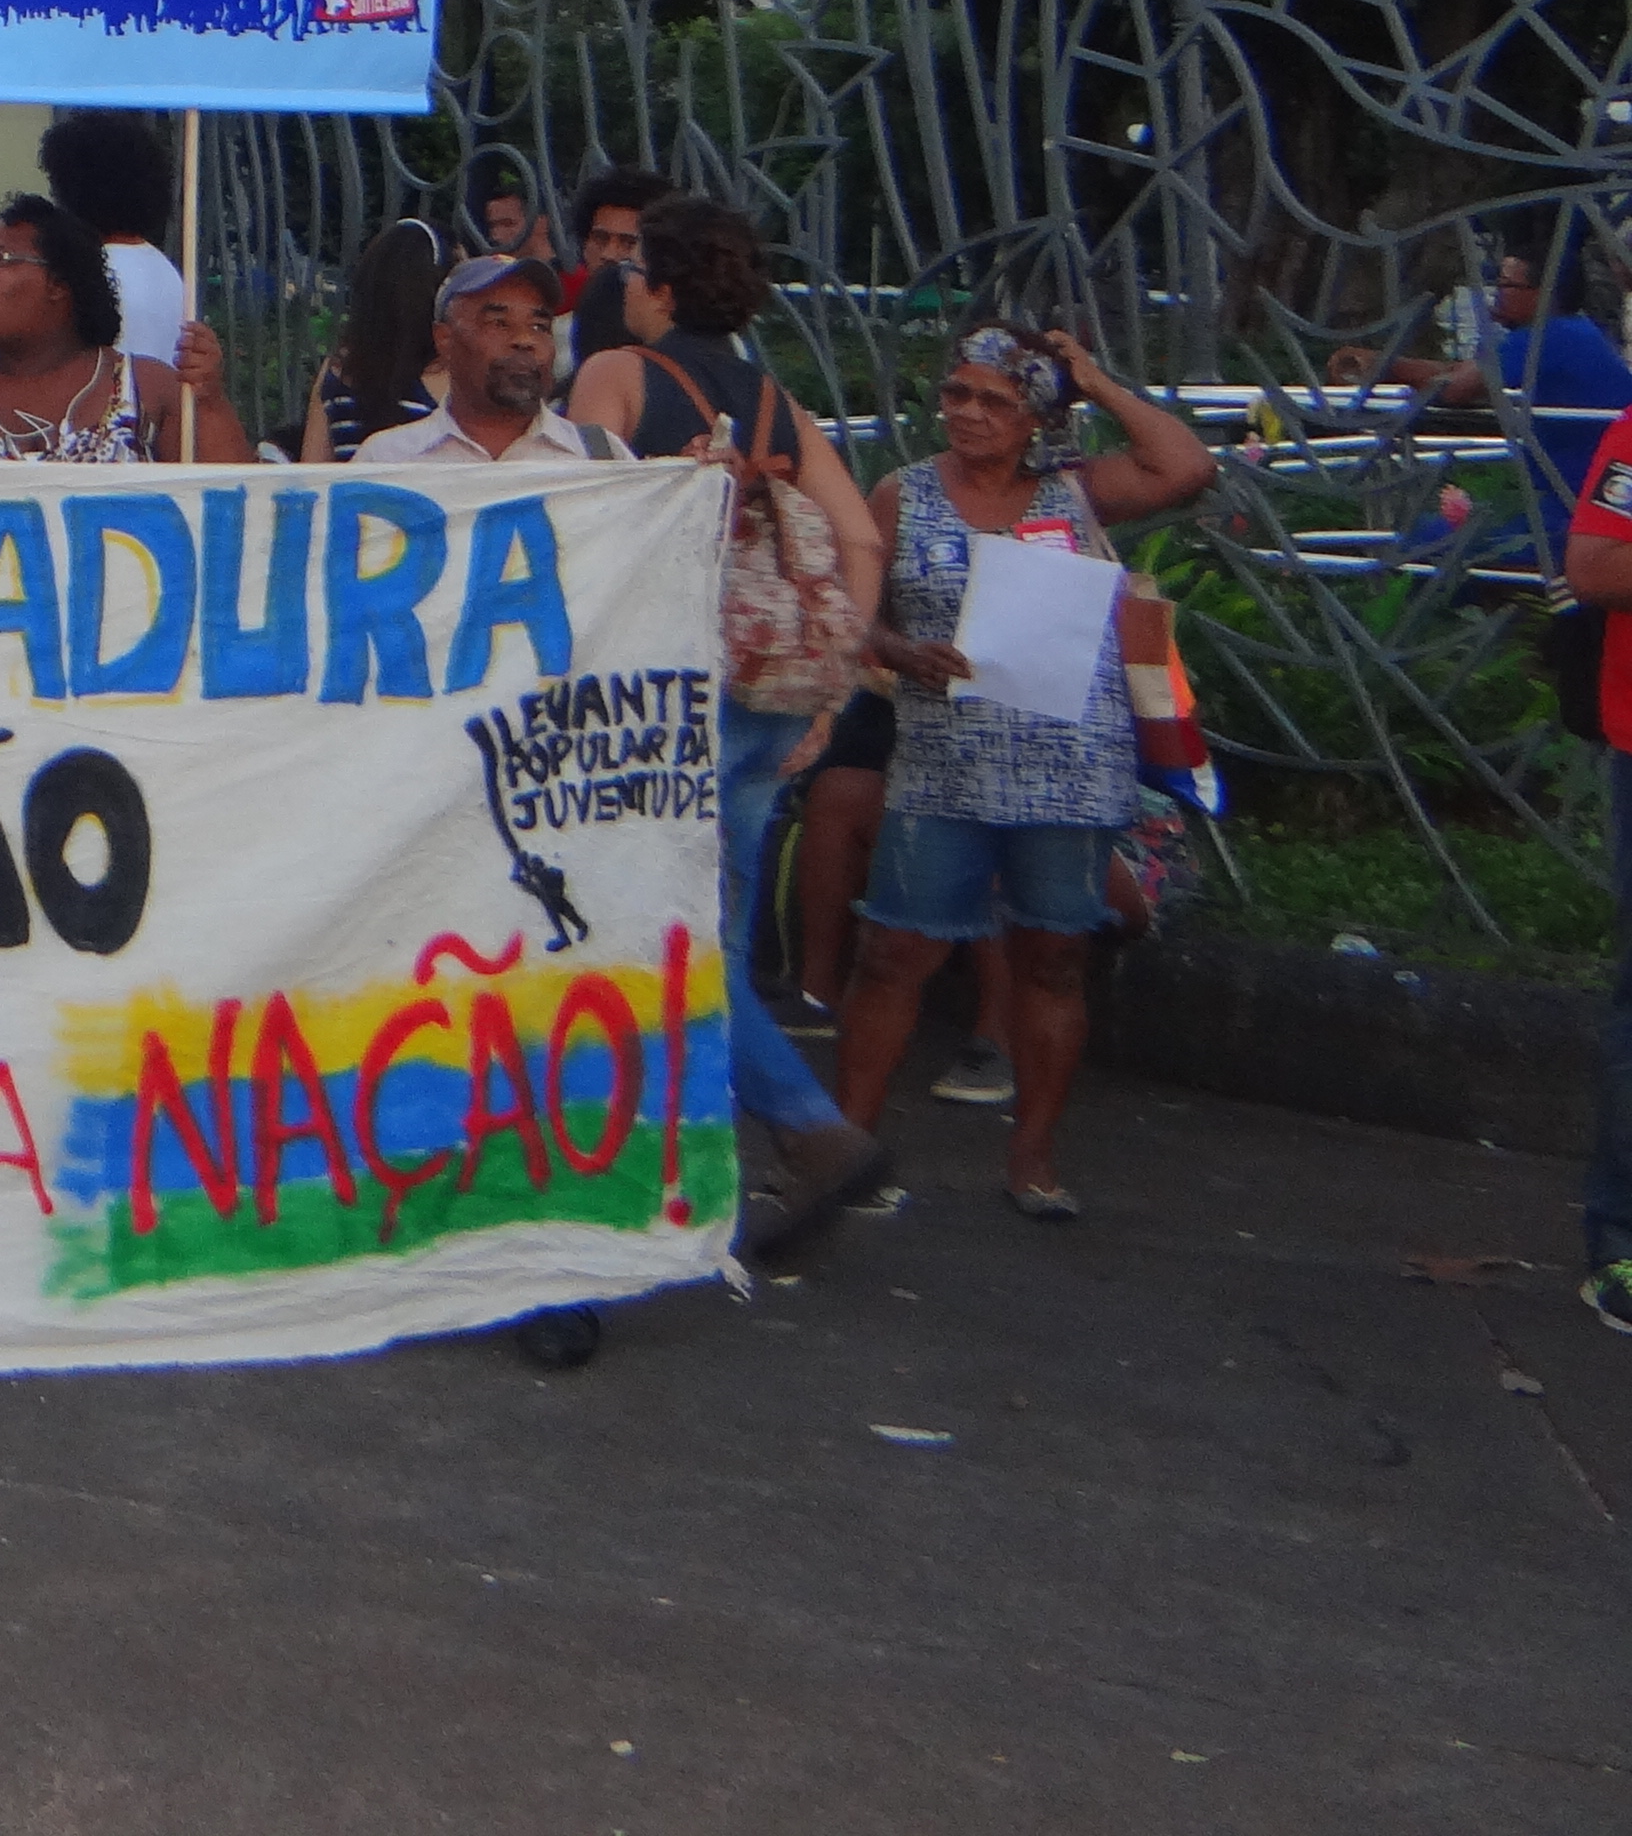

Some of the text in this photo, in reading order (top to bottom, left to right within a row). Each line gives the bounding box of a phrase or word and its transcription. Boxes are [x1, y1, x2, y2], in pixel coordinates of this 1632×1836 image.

[491, 667, 710, 754] LEVANTE
[673, 722, 713, 768] DA
[511, 768, 716, 830] JUVENTUDE
[132, 922, 694, 1243] NAÇÃO!
